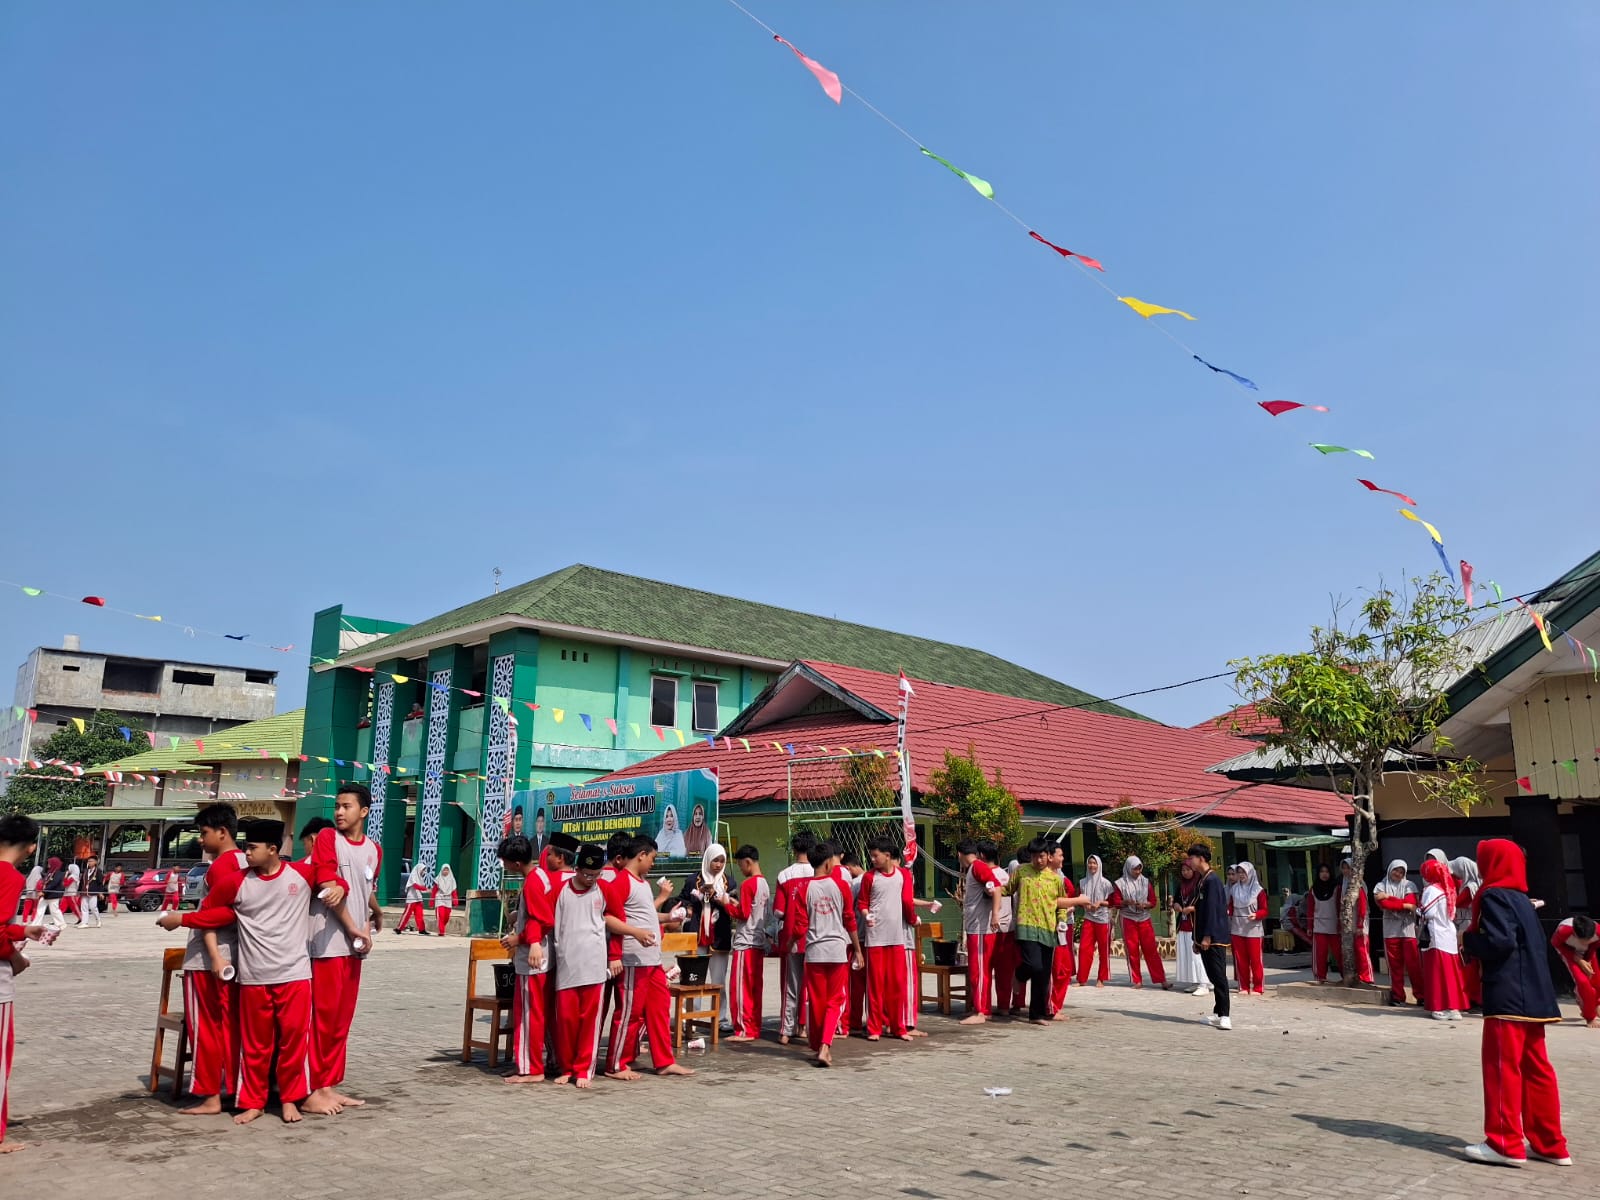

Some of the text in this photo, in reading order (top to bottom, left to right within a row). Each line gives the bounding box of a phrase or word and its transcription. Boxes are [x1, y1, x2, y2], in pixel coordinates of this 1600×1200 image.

[570, 787, 601, 801] Selamat
[608, 783, 635, 797] Sukses
[552, 804, 576, 821] UJIAN
[576, 798, 626, 818] MADRASAH
[562, 820, 581, 833] MTsN
[586, 818, 602, 831] KOTA
[604, 816, 641, 830] BENGKULU
